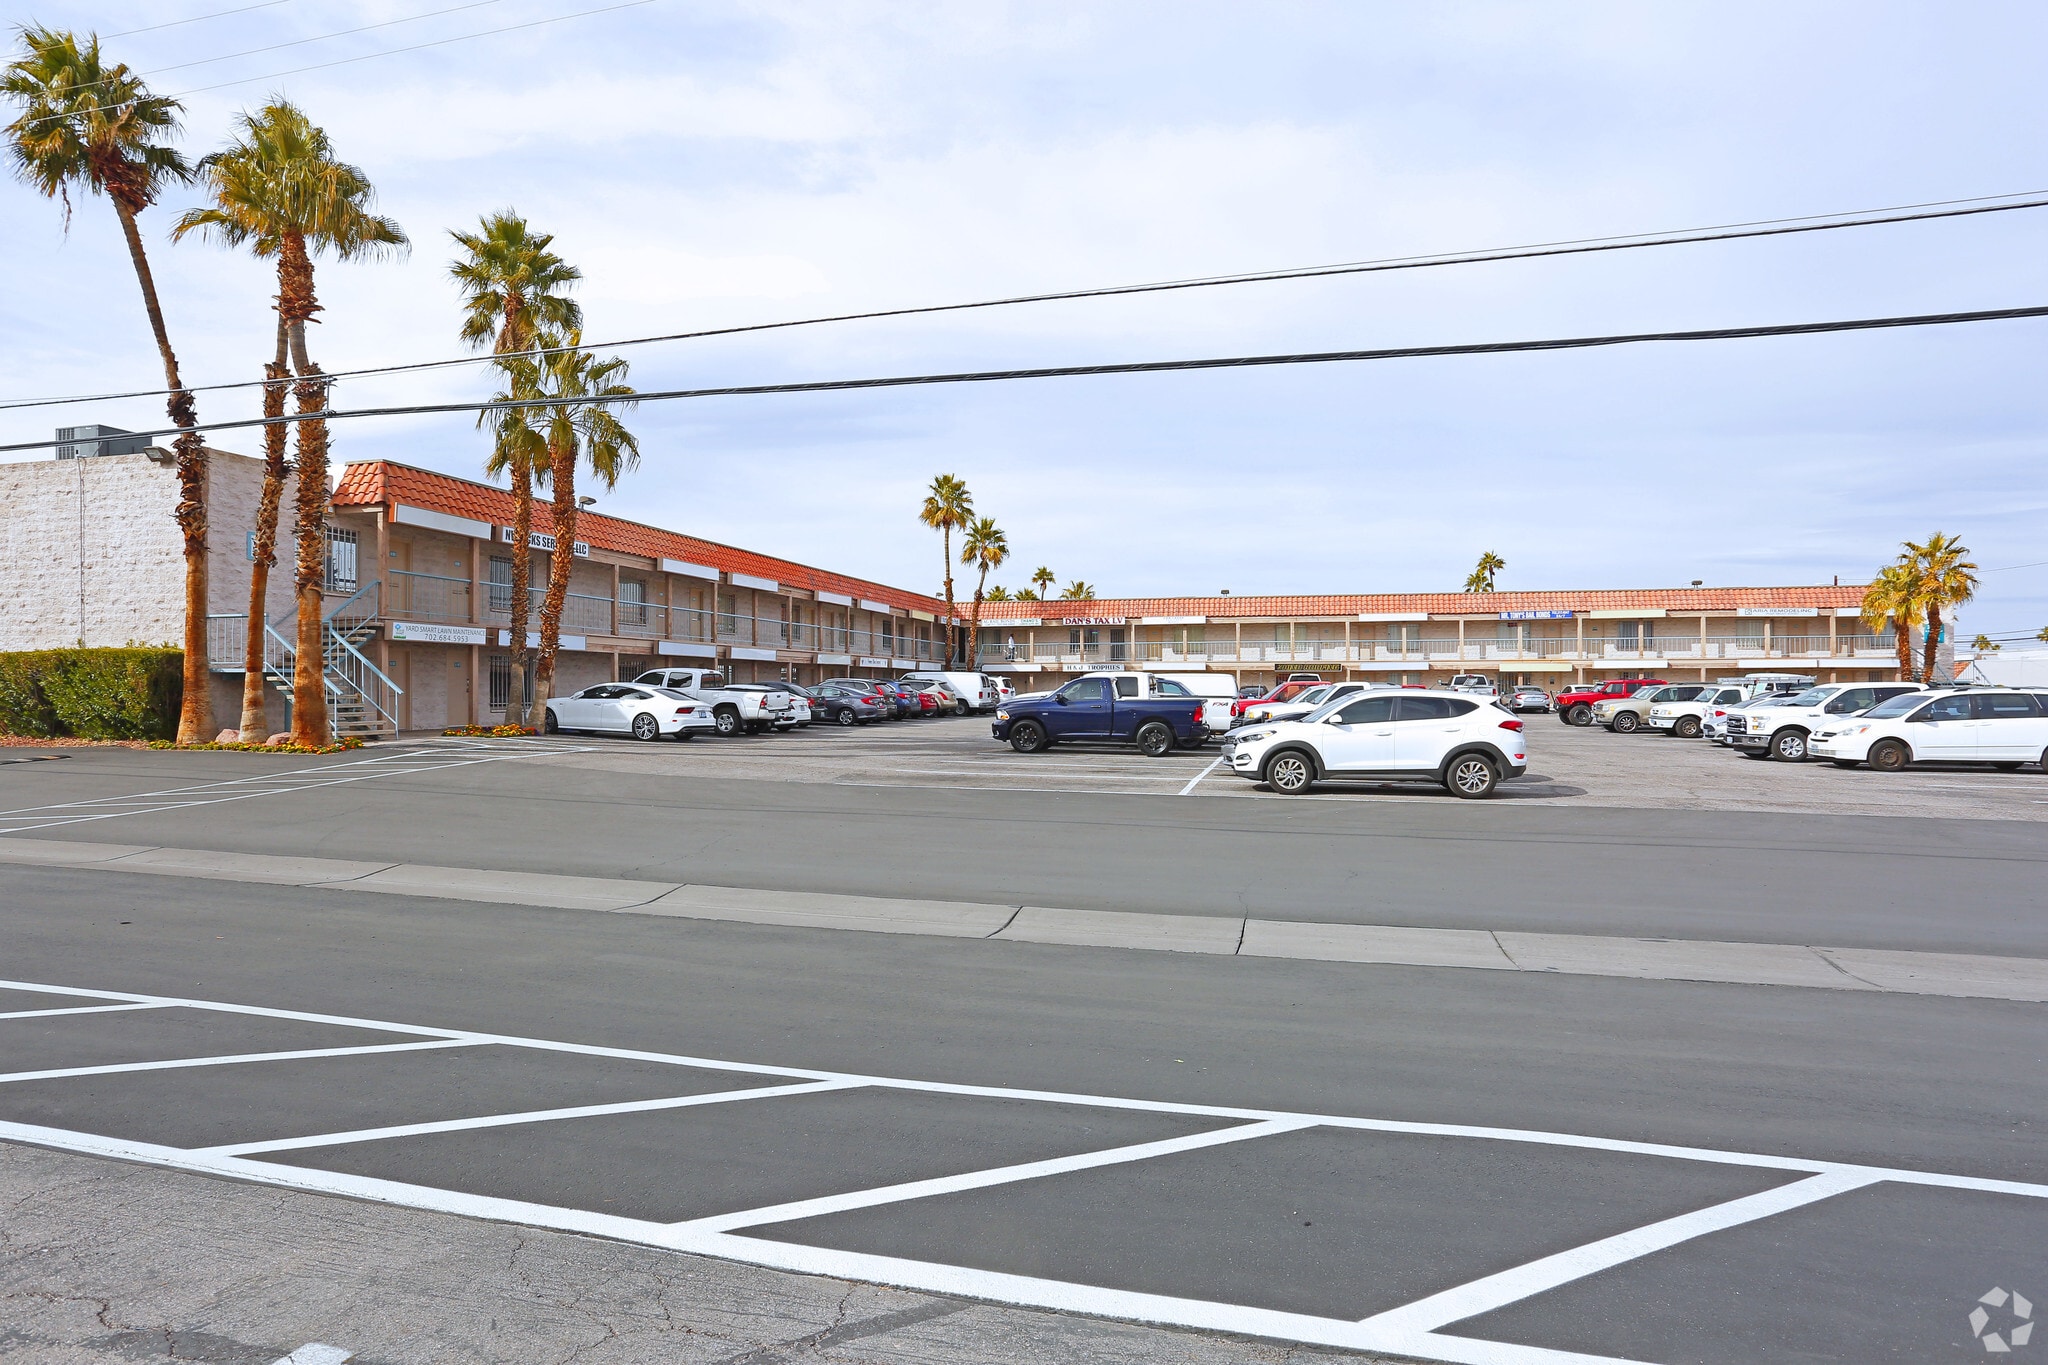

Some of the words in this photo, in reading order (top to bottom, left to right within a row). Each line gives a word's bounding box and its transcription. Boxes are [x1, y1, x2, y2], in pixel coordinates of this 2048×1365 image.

[1065, 617, 1091, 625] DAN'S
[1093, 617, 1110, 625] TAX
[405, 625, 418, 633] YARD
[453, 628, 485, 637] MAINTENANCE
[424, 633, 469, 643] 702.684.5953
